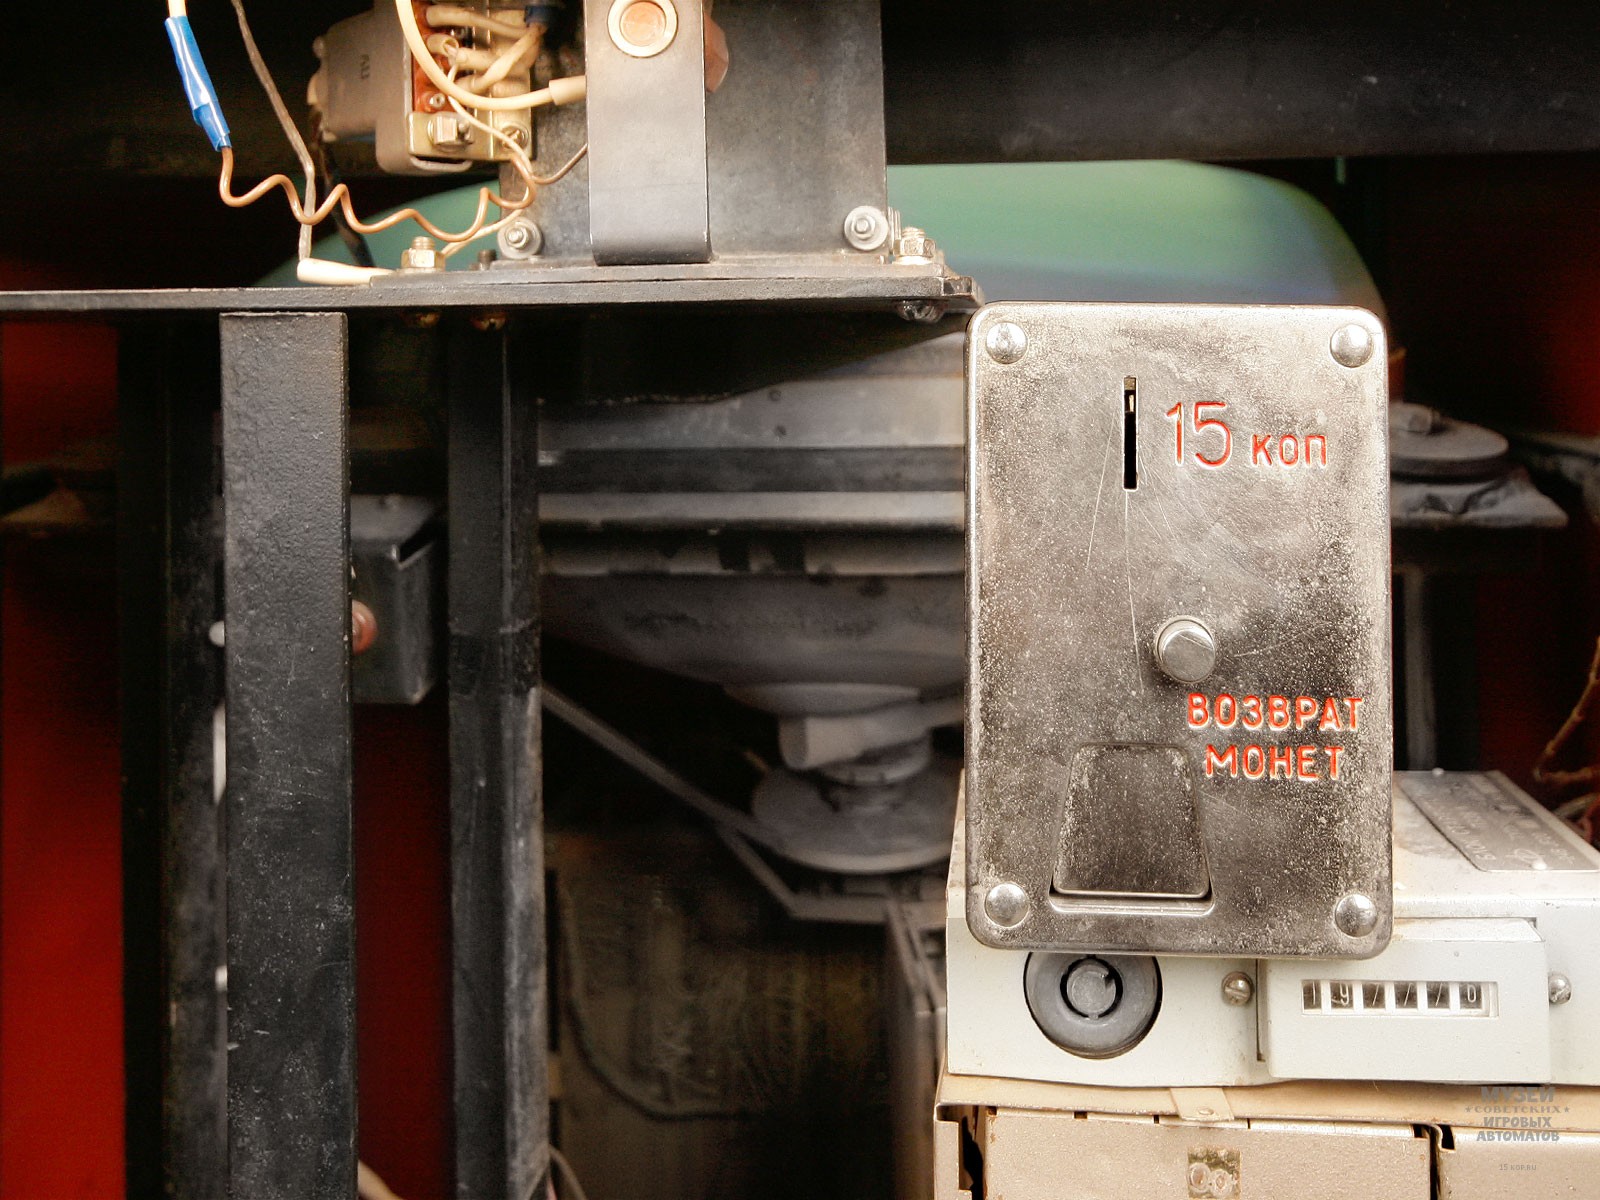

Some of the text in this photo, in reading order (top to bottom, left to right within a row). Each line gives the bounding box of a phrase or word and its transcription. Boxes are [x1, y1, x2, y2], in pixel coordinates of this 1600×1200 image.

[1165, 401, 1232, 467] 15
[1187, 692, 1362, 729] ВОЗВРАТ
[1205, 743, 1343, 779] МОНЕТ
